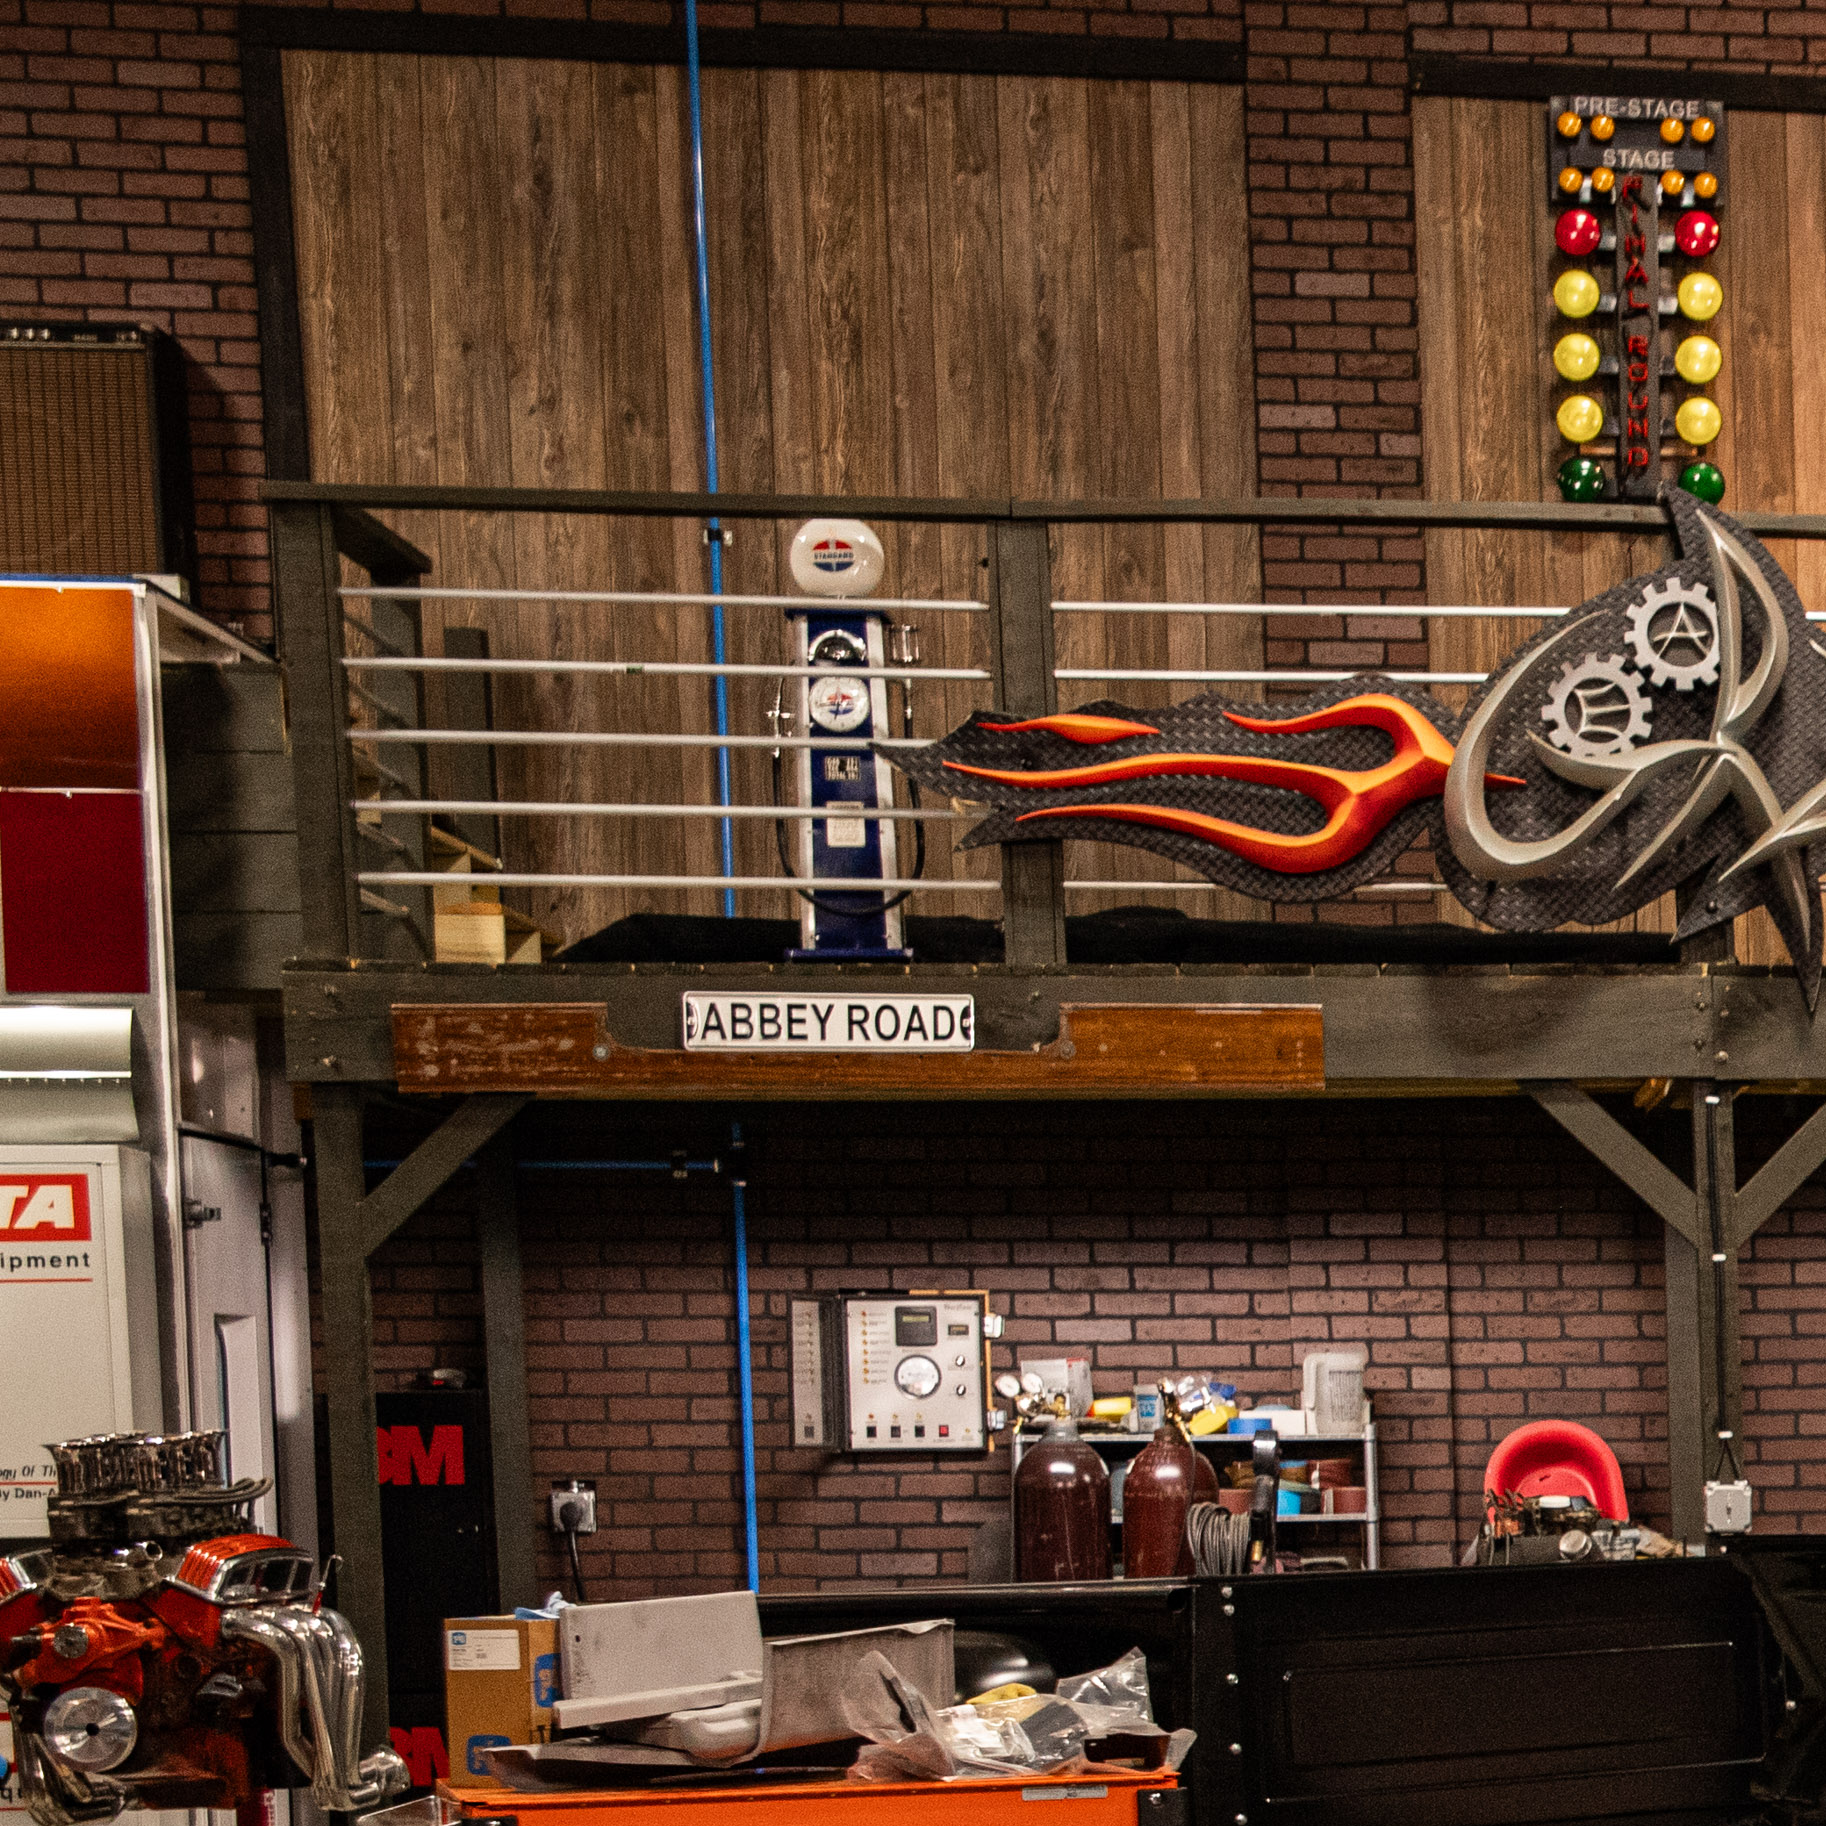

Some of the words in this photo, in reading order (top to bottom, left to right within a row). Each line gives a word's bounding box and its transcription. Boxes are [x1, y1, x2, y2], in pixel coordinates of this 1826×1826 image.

[1574, 97, 1700, 120] PRE-STAGE
[1603, 148, 1675, 170] STAGE
[1627, 335, 1649, 467] ROUND
[701, 1002, 835, 1042] ABBEY
[847, 1003, 956, 1043] ROAD
